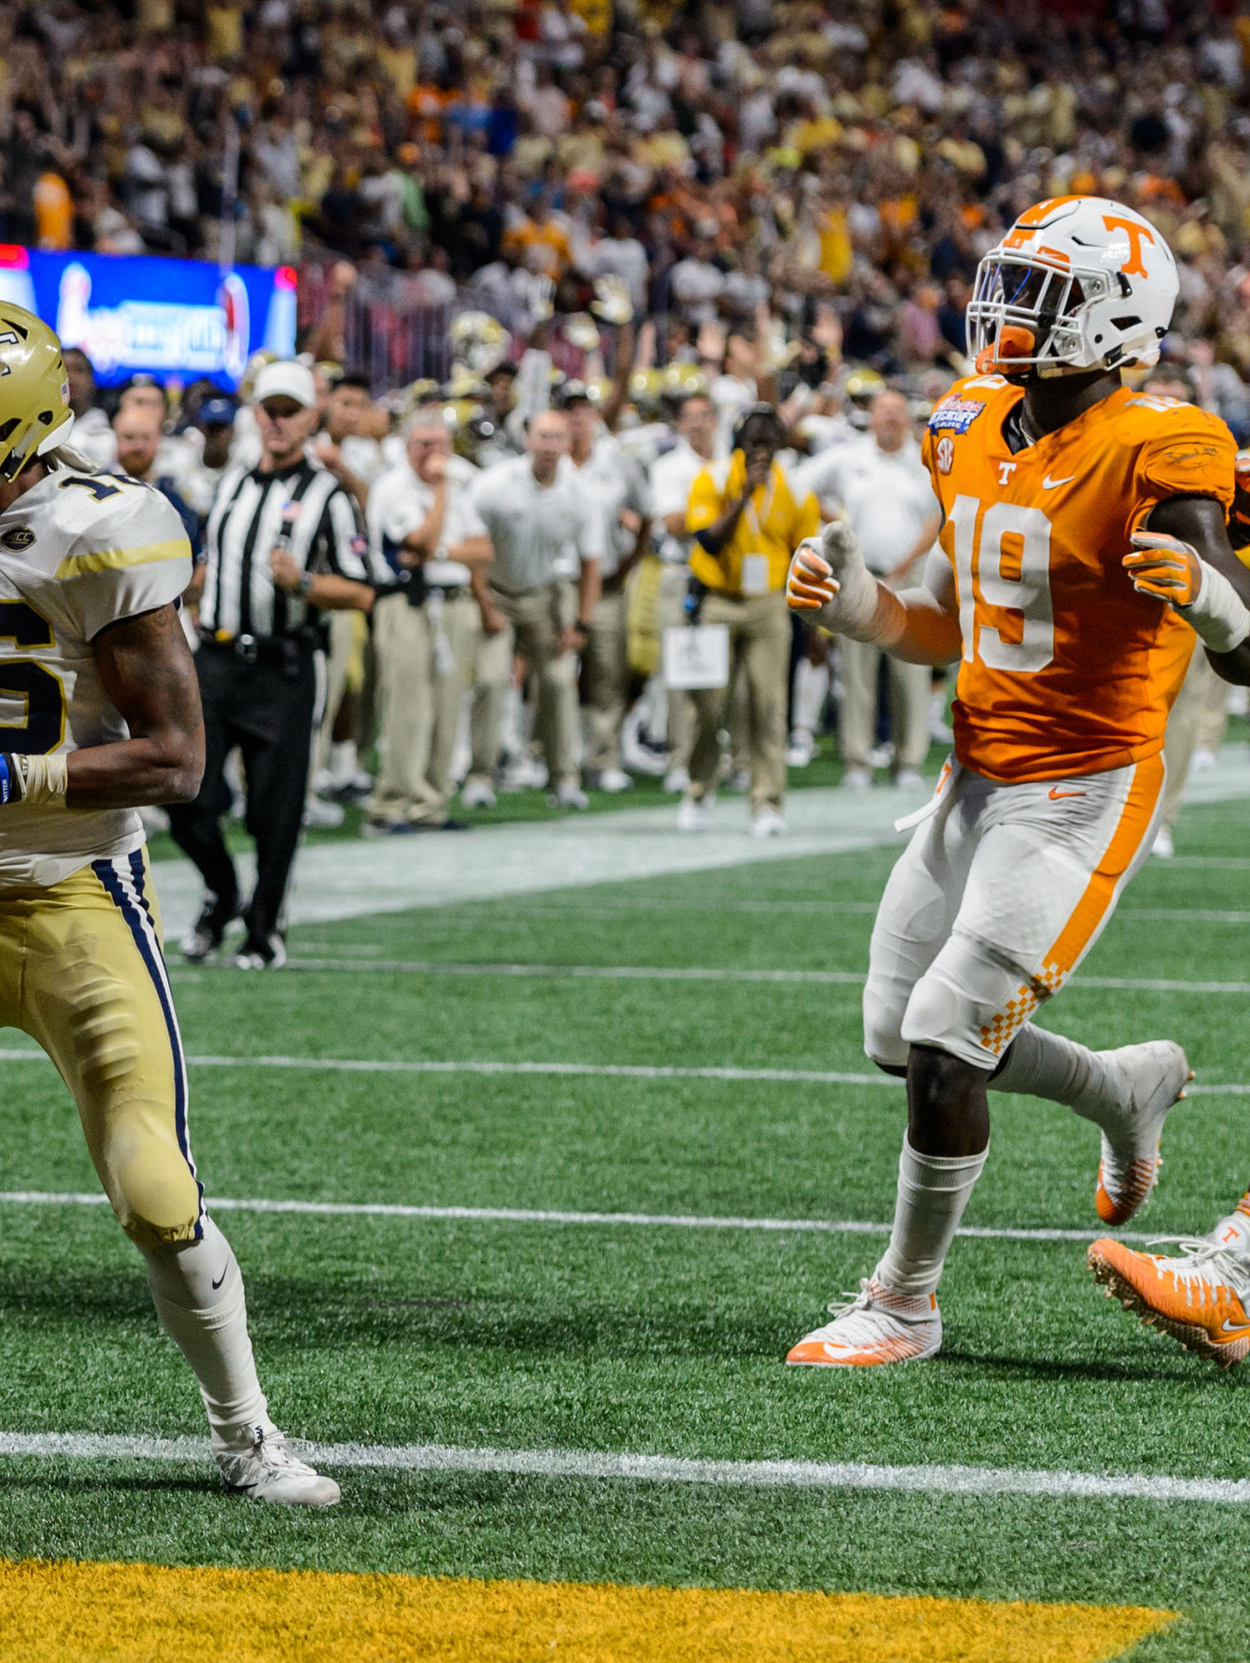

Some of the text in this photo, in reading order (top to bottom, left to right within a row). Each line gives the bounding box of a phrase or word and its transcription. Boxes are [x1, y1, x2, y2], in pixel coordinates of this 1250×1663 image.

[1101, 214, 1156, 280] T
[997, 460, 1018, 486] T
[947, 493, 1055, 673] 19
[1221, 1225, 1240, 1244] T
